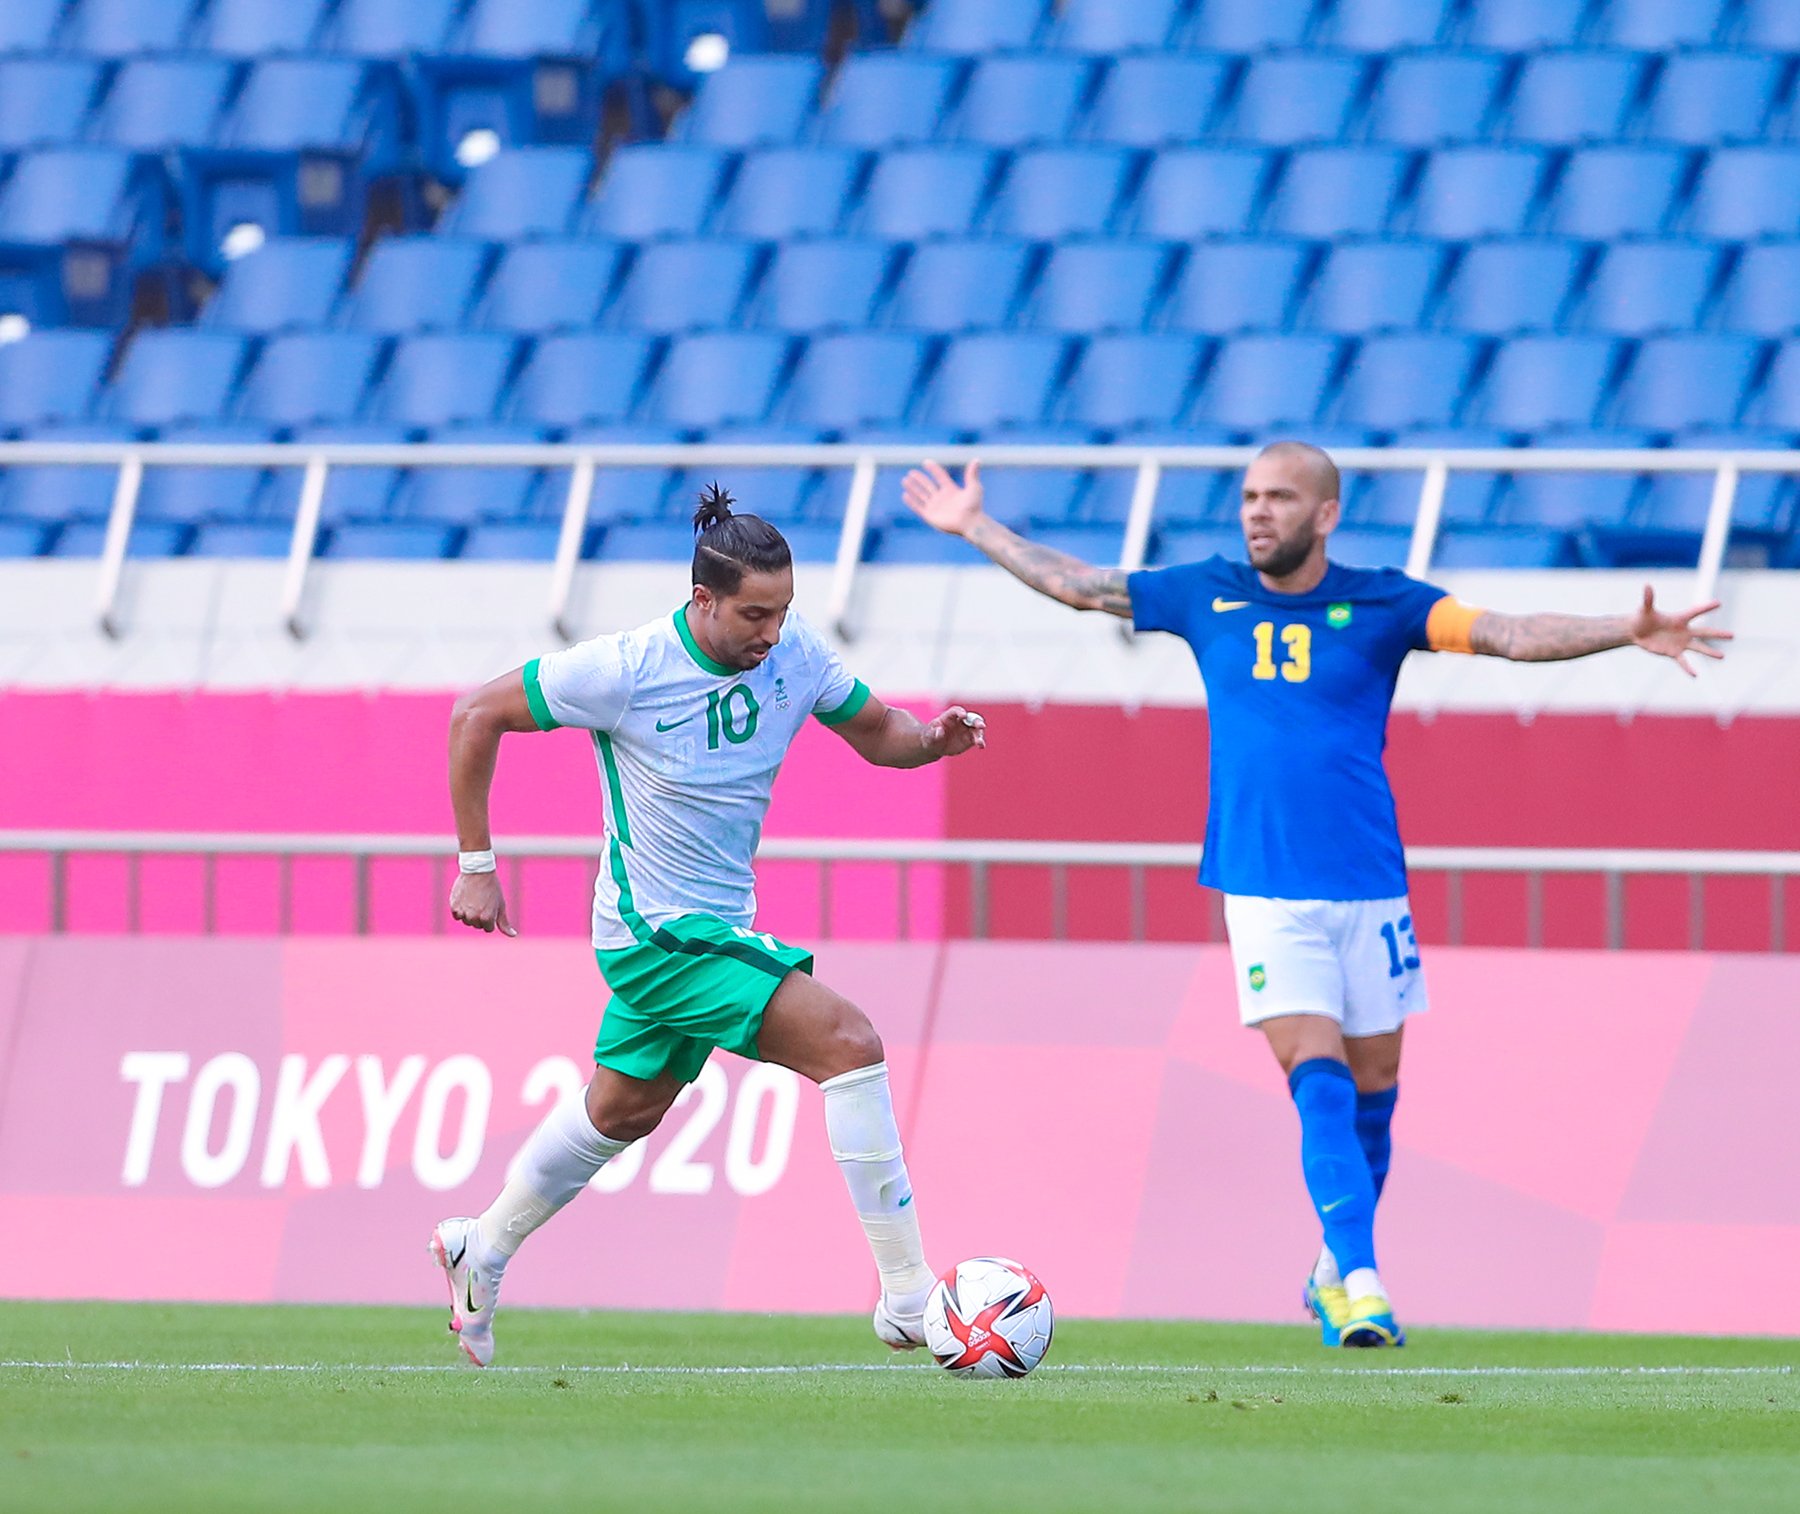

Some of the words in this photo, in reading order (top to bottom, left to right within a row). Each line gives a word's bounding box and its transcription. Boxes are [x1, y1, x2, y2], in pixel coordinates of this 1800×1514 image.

[1252, 621, 1312, 683] 13
[706, 683, 760, 750] 10
[119, 1050, 493, 1191] TOKYO
